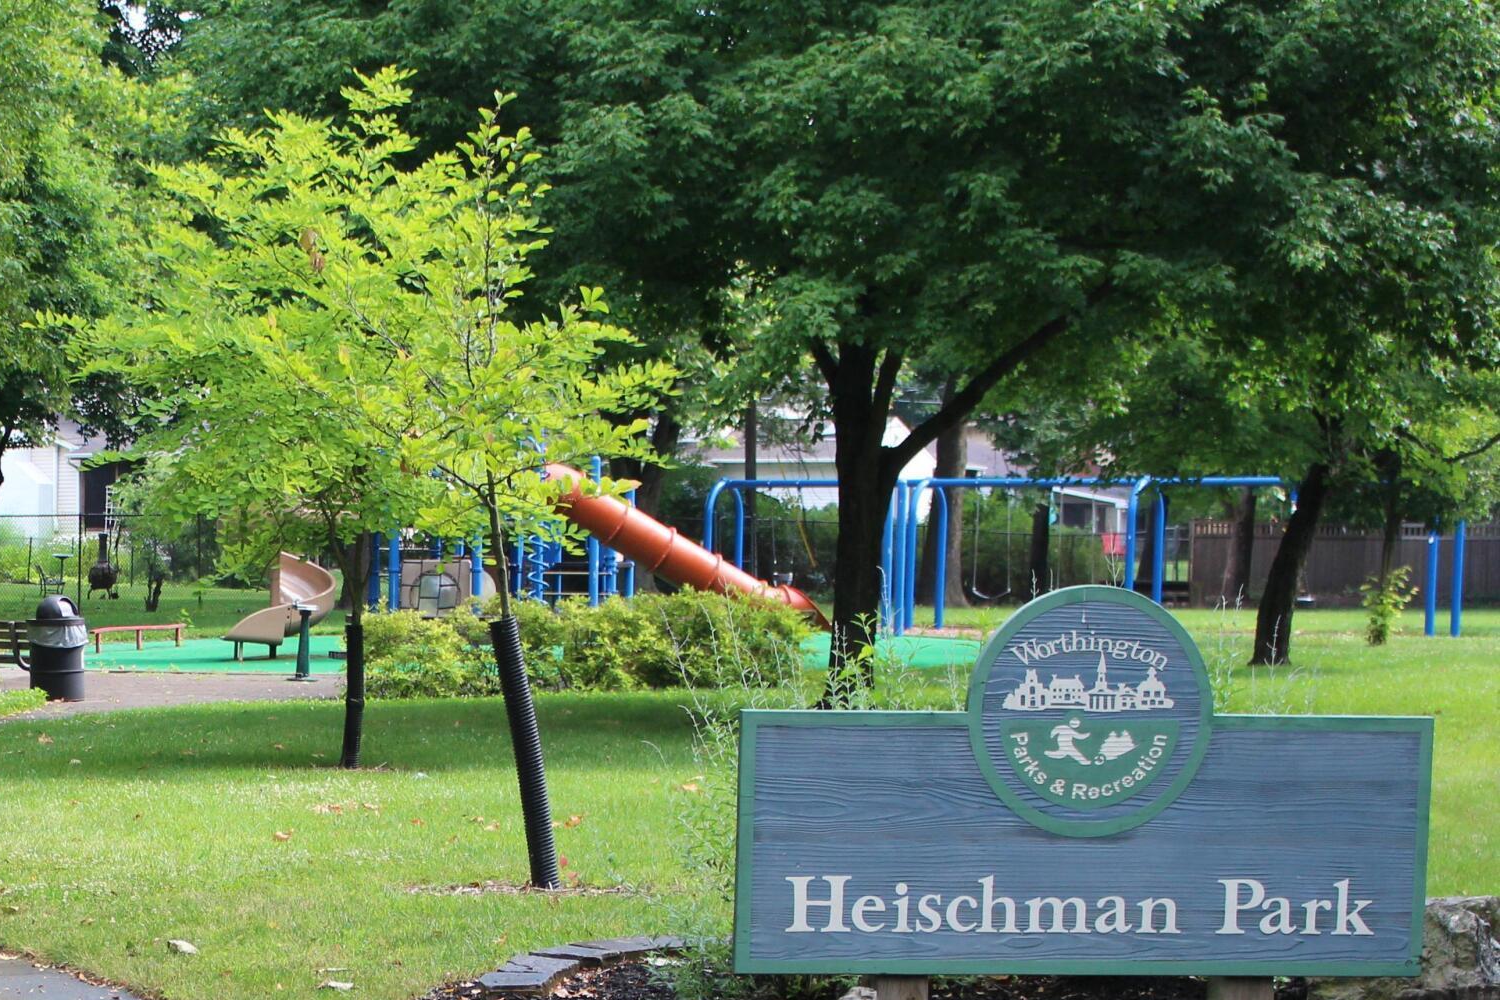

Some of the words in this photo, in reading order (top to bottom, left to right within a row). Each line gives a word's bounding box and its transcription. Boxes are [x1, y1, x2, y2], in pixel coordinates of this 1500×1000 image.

[1010, 630, 1168, 671] Worthington
[1010, 731, 1047, 785] Parks
[1049, 779, 1065, 796] &
[1071, 734, 1168, 800] Recreation
[785, 875, 1182, 935] Heischman
[1216, 877, 1374, 936] Park
